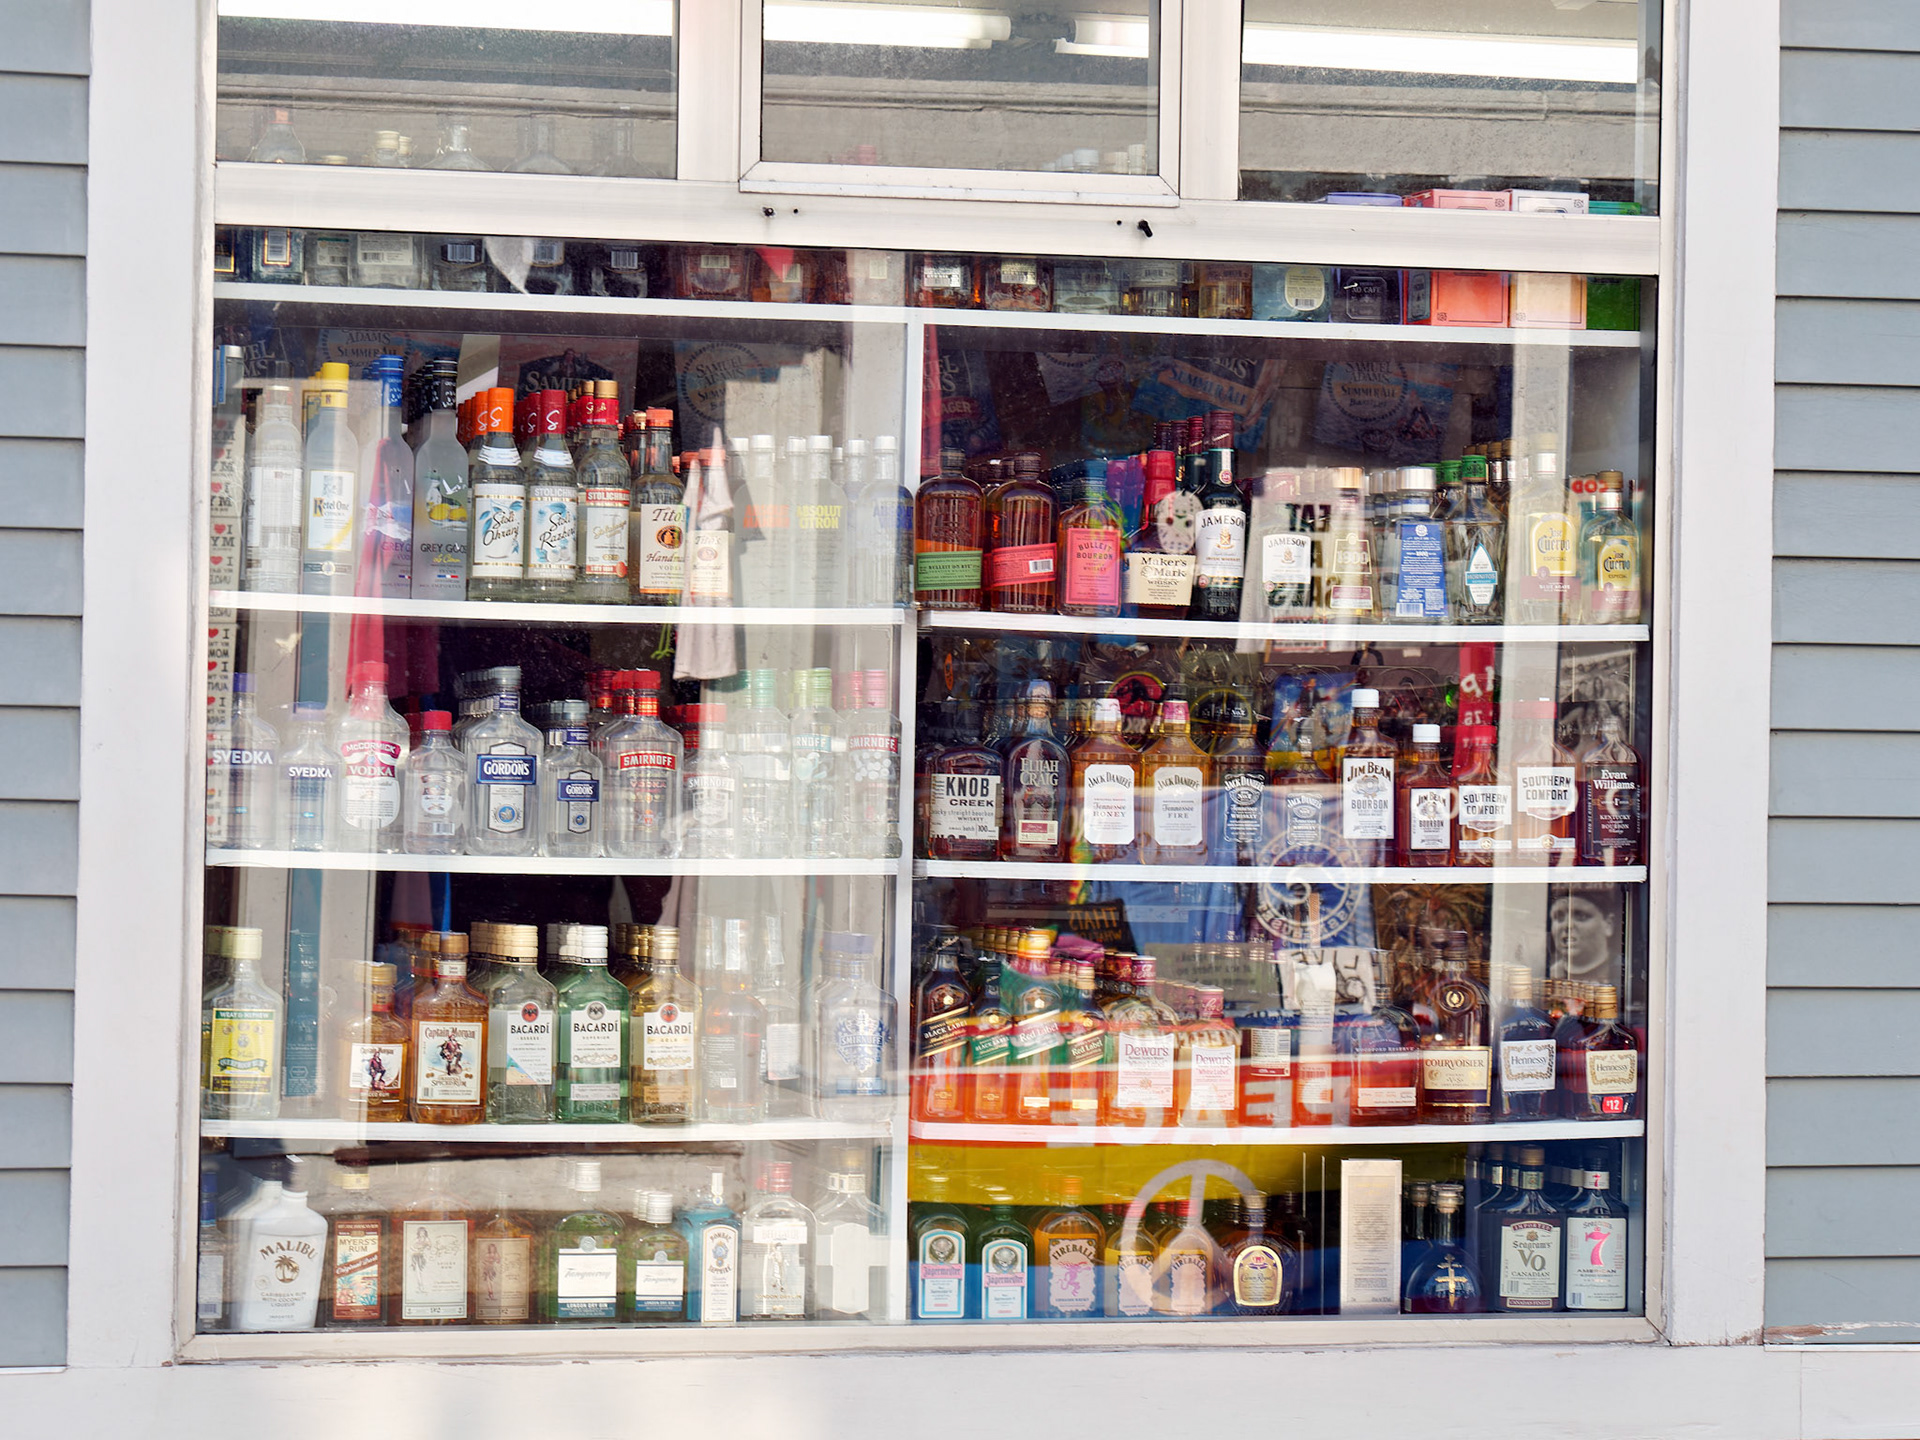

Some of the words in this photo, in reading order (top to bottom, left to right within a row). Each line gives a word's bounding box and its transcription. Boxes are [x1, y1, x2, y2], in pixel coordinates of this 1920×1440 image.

[346, 331, 391, 345] ADAMS
[941, 401, 972, 413] AGER
[534, 487, 577, 498] STOLICHN
[313, 497, 336, 518] Ketel
[336, 500, 350, 511] One
[797, 505, 843, 518] ABSOLUT
[493, 510, 516, 530] Stoli
[550, 511, 571, 532] Stoli
[799, 516, 839, 529] CITRON
[1201, 513, 1246, 529] JAMESON
[1549, 528, 1563, 538] Jose
[420, 543, 443, 553] GREY
[1078, 542, 1113, 551] BULLEIT
[1268, 537, 1307, 549] JAMESON
[1537, 535, 1571, 554] Cuervo
[1077, 552, 1113, 560] BOURBON
[1141, 556, 1187, 567] Maker's
[1603, 556, 1631, 573] Cuervo
[1153, 568, 1187, 578] Mark
[345, 743, 396, 754] McCORMICK
[796, 736, 827, 748] RNOFF
[849, 735, 896, 749] SMIRNOFF
[212, 750, 273, 765] SVEDKA
[623, 755, 673, 767] SMIRNOFF
[349, 765, 393, 777] VODKA
[1020, 758, 1060, 772] ELIJAH
[1347, 765, 1366, 782] JIM
[1367, 761, 1392, 782] BEAM
[289, 766, 333, 778] SVEDKA
[1600, 769, 1628, 780] Evan
[946, 776, 990, 797] KNOB
[1020, 772, 1059, 788] CRAIG
[1088, 774, 1106, 789] JACK
[1157, 778, 1175, 791] JACK
[1224, 777, 1241, 791] JACK
[1522, 775, 1572, 788] SOUTHERN
[1593, 779, 1635, 790] Williams
[1416, 794, 1429, 807] JIM
[1428, 791, 1447, 807] BEAM
[1463, 792, 1508, 804] SOUTHERN
[1525, 789, 1569, 801] COMFORT
[949, 799, 995, 807] CREEK
[1351, 799, 1389, 810] BOURBON
[1466, 805, 1505, 815] COMFORT
[1418, 819, 1444, 828] BOURBON
[424, 1027, 449, 1039] Captain
[451, 1027, 476, 1039] Morgan
[510, 1022, 550, 1034] BACARDÍ
[573, 1020, 618, 1033] BACARDÍ
[646, 1022, 692, 1035] BACARDÍ
[923, 1027, 947, 1040] BLACK
[946, 1020, 968, 1034] LABEL
[1019, 1030, 1037, 1043] Red
[1037, 1021, 1060, 1037] Label
[840, 1036, 883, 1045] SMIRNOFF
[1071, 1045, 1085, 1057] Red
[1084, 1038, 1103, 1053] Label
[1124, 1043, 1169, 1056] Dewar's
[1195, 1054, 1232, 1065] Dewar's
[1425, 1057, 1484, 1070] COURVOISIER
[1511, 1055, 1547, 1066] Hennessy
[1596, 1063, 1629, 1073] Hennessy
[1605, 1099, 1620, 1110] $12
[1512, 1222, 1552, 1232] IMPORTED
[339, 1238, 377, 1246] MYERS'S
[1512, 1240, 1552, 1250] Seagram's
[260, 1240, 319, 1261] MALIBU
[1051, 1243, 1097, 1261] FIREBALL
[1584, 1231, 1611, 1267] 7
[1120, 1257, 1152, 1271] FIREBALL
[1173, 1257, 1206, 1273] FIREBALL
[1517, 1249, 1546, 1272] VO
